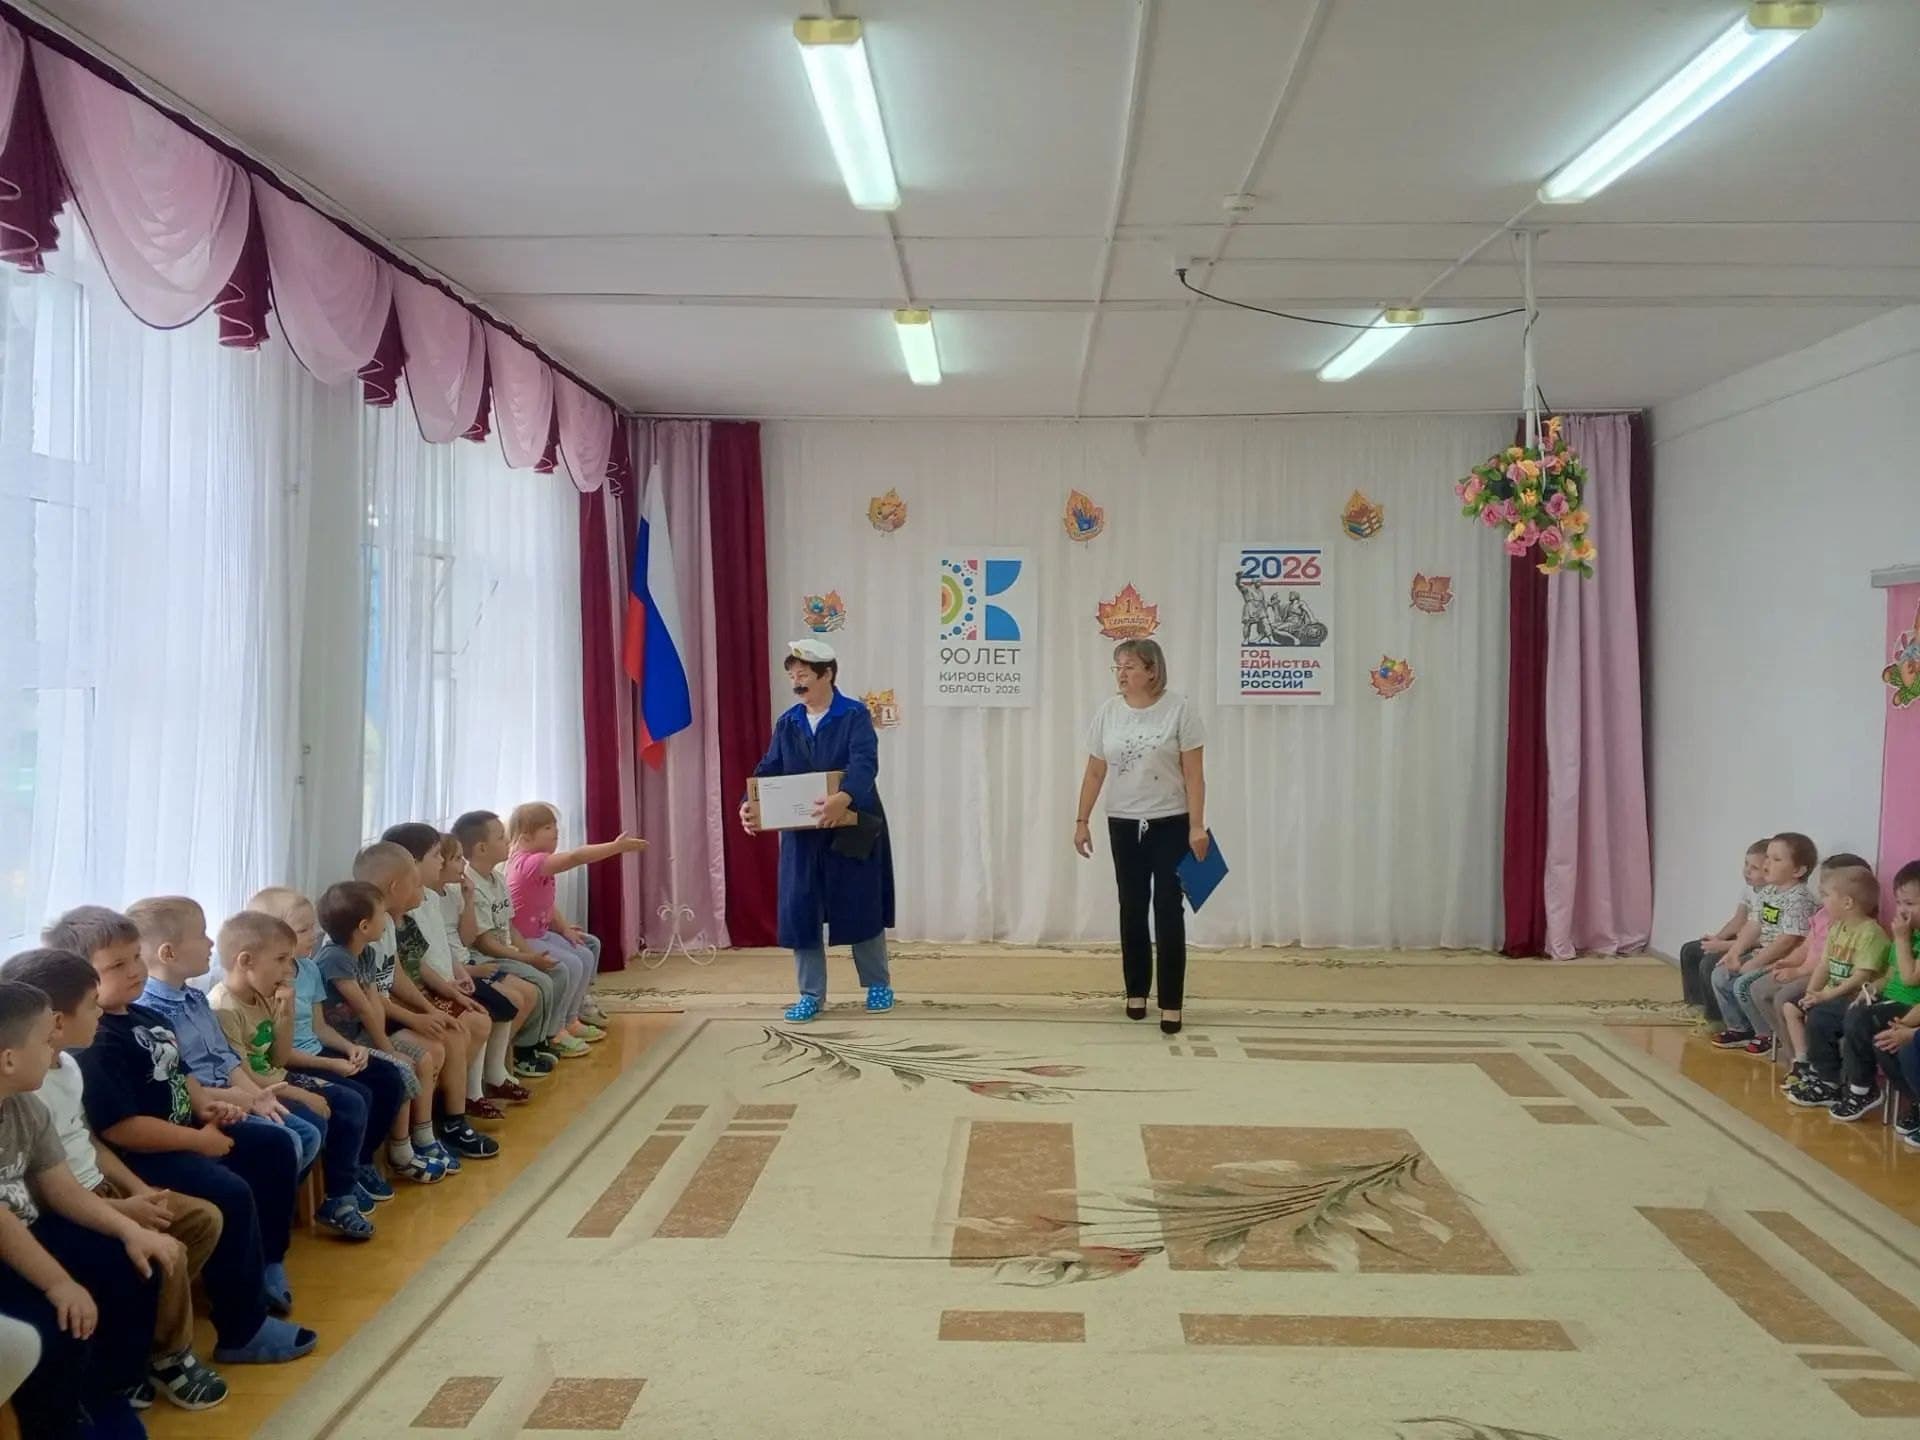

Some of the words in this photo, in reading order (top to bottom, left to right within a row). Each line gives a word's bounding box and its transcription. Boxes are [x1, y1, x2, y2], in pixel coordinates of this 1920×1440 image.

[1240, 556, 1321, 579] 2026
[940, 648, 970, 664] 90
[974, 648, 1021, 664] ЛЕТ
[1241, 650, 1271, 659] ГОД
[1241, 660, 1321, 669] ЕДИНСТВА
[939, 672, 1021, 682] КИРОВСКАЯ
[1241, 670, 1313, 679] НАРОДОВ
[1241, 680, 1304, 688] РОССИИ
[939, 684, 991, 694] ОБЛАСТЬ
[996, 685, 1021, 694] 2026
